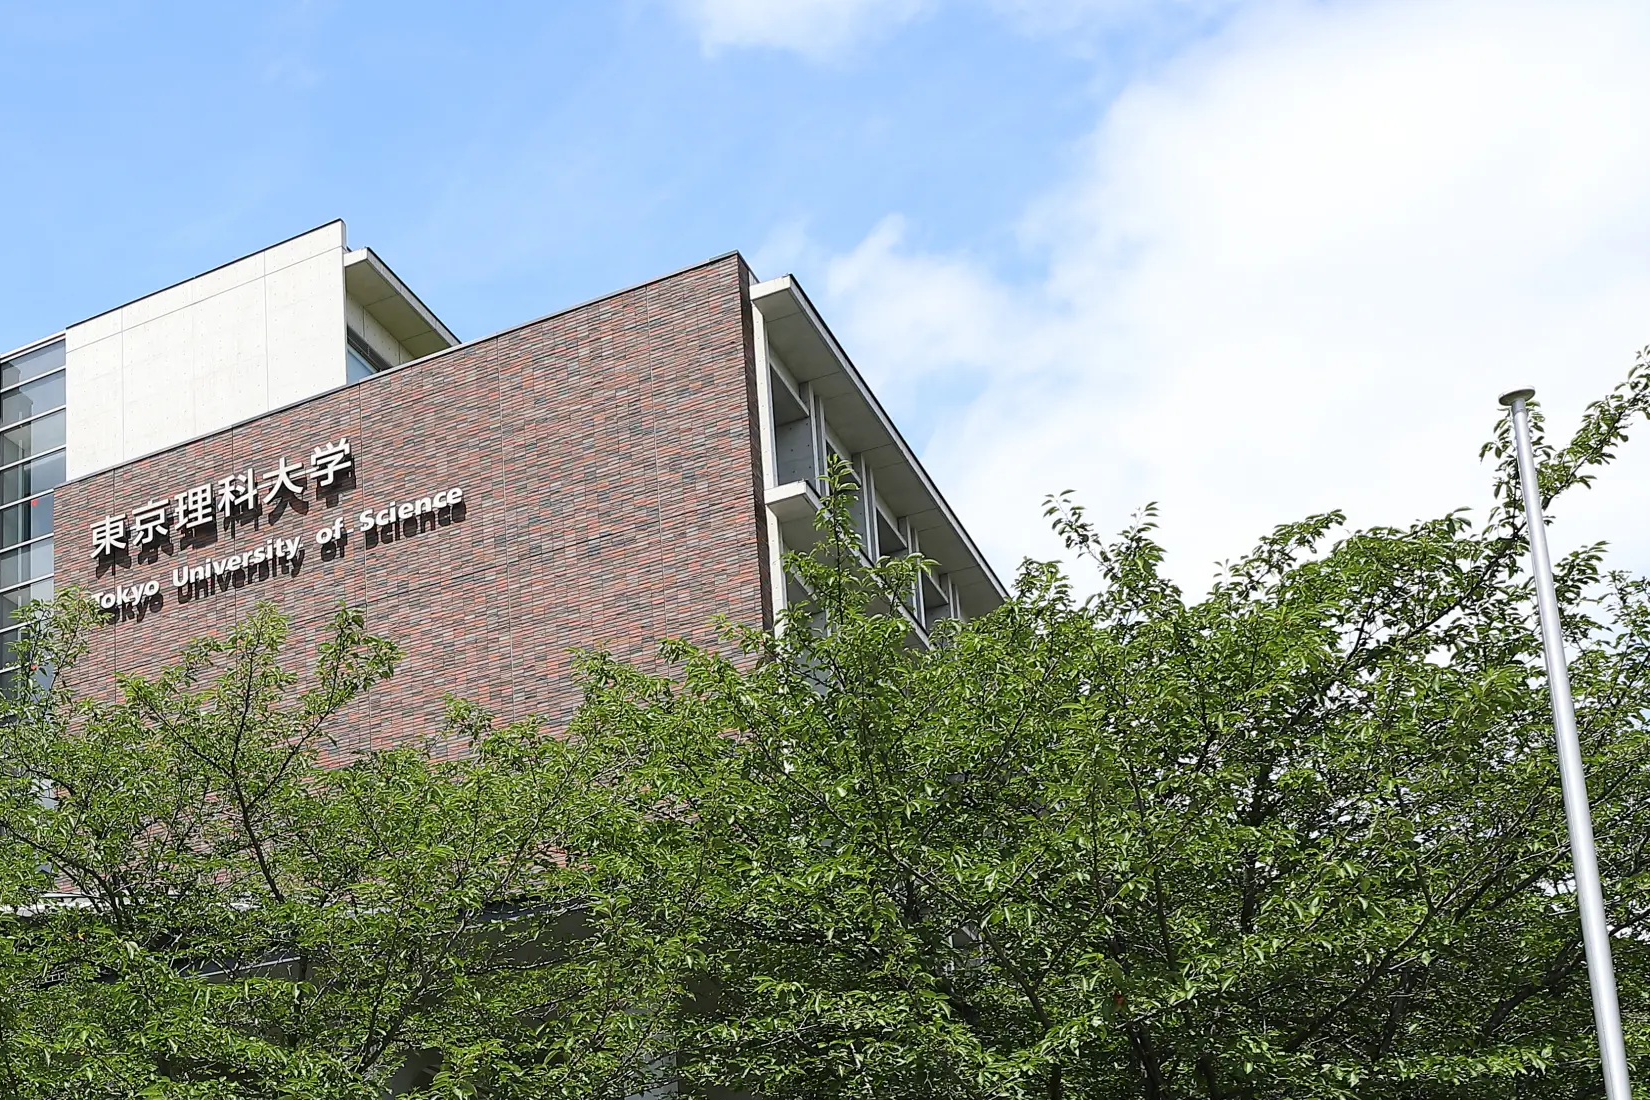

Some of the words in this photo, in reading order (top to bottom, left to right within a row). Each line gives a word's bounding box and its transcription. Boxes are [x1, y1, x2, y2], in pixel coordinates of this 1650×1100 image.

[88, 437, 352, 559] 東京理科大学
[91, 580, 160, 609] Tokyo
[172, 536, 301, 588] University
[315, 517, 344, 546] of
[359, 487, 463, 532] Science
